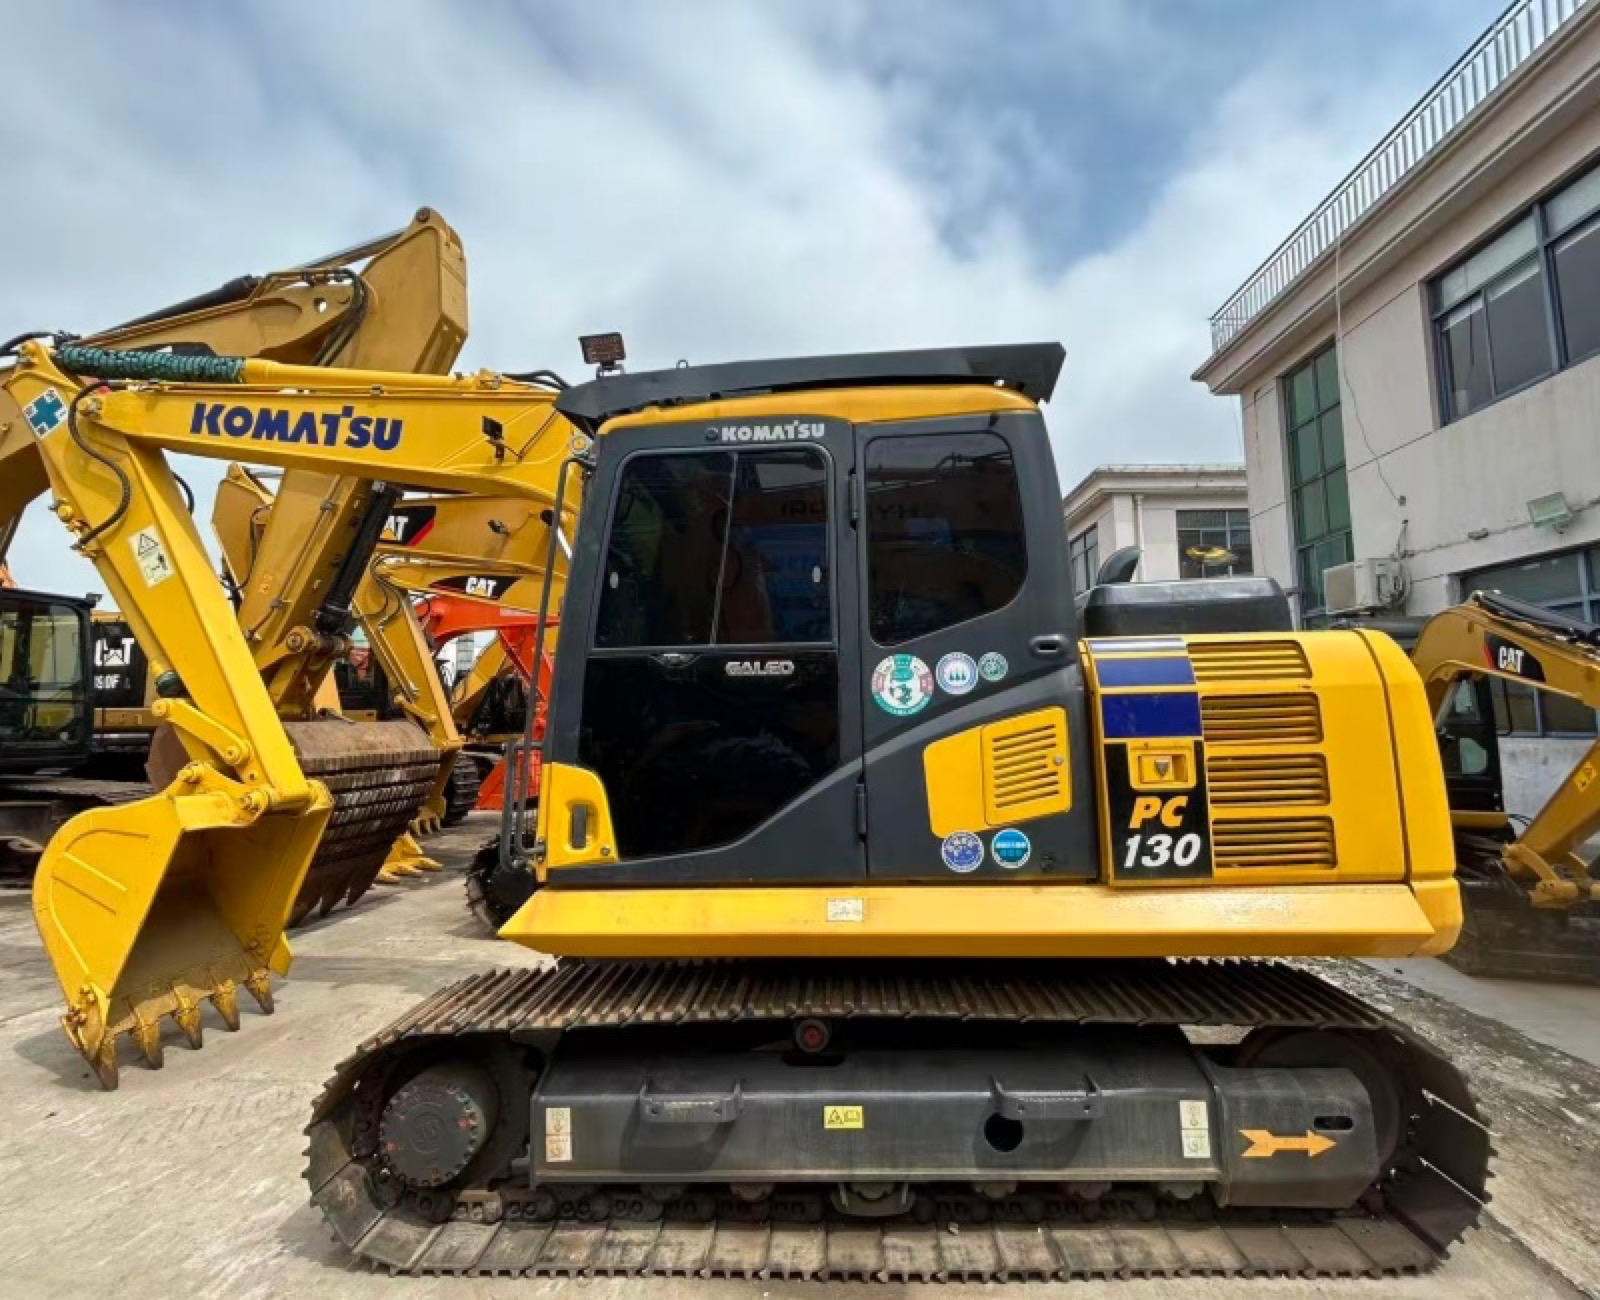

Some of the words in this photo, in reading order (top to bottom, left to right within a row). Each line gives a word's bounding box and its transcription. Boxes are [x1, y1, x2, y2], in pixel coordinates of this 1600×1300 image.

[190, 402, 403, 450] KOMATSU
[721, 420, 825, 441] KOMATSU
[380, 515, 409, 540] AT
[465, 576, 496, 597] CAT
[1498, 645, 1524, 674] CAT
[1128, 796, 1188, 829] PC
[1124, 832, 1201, 869] 130
